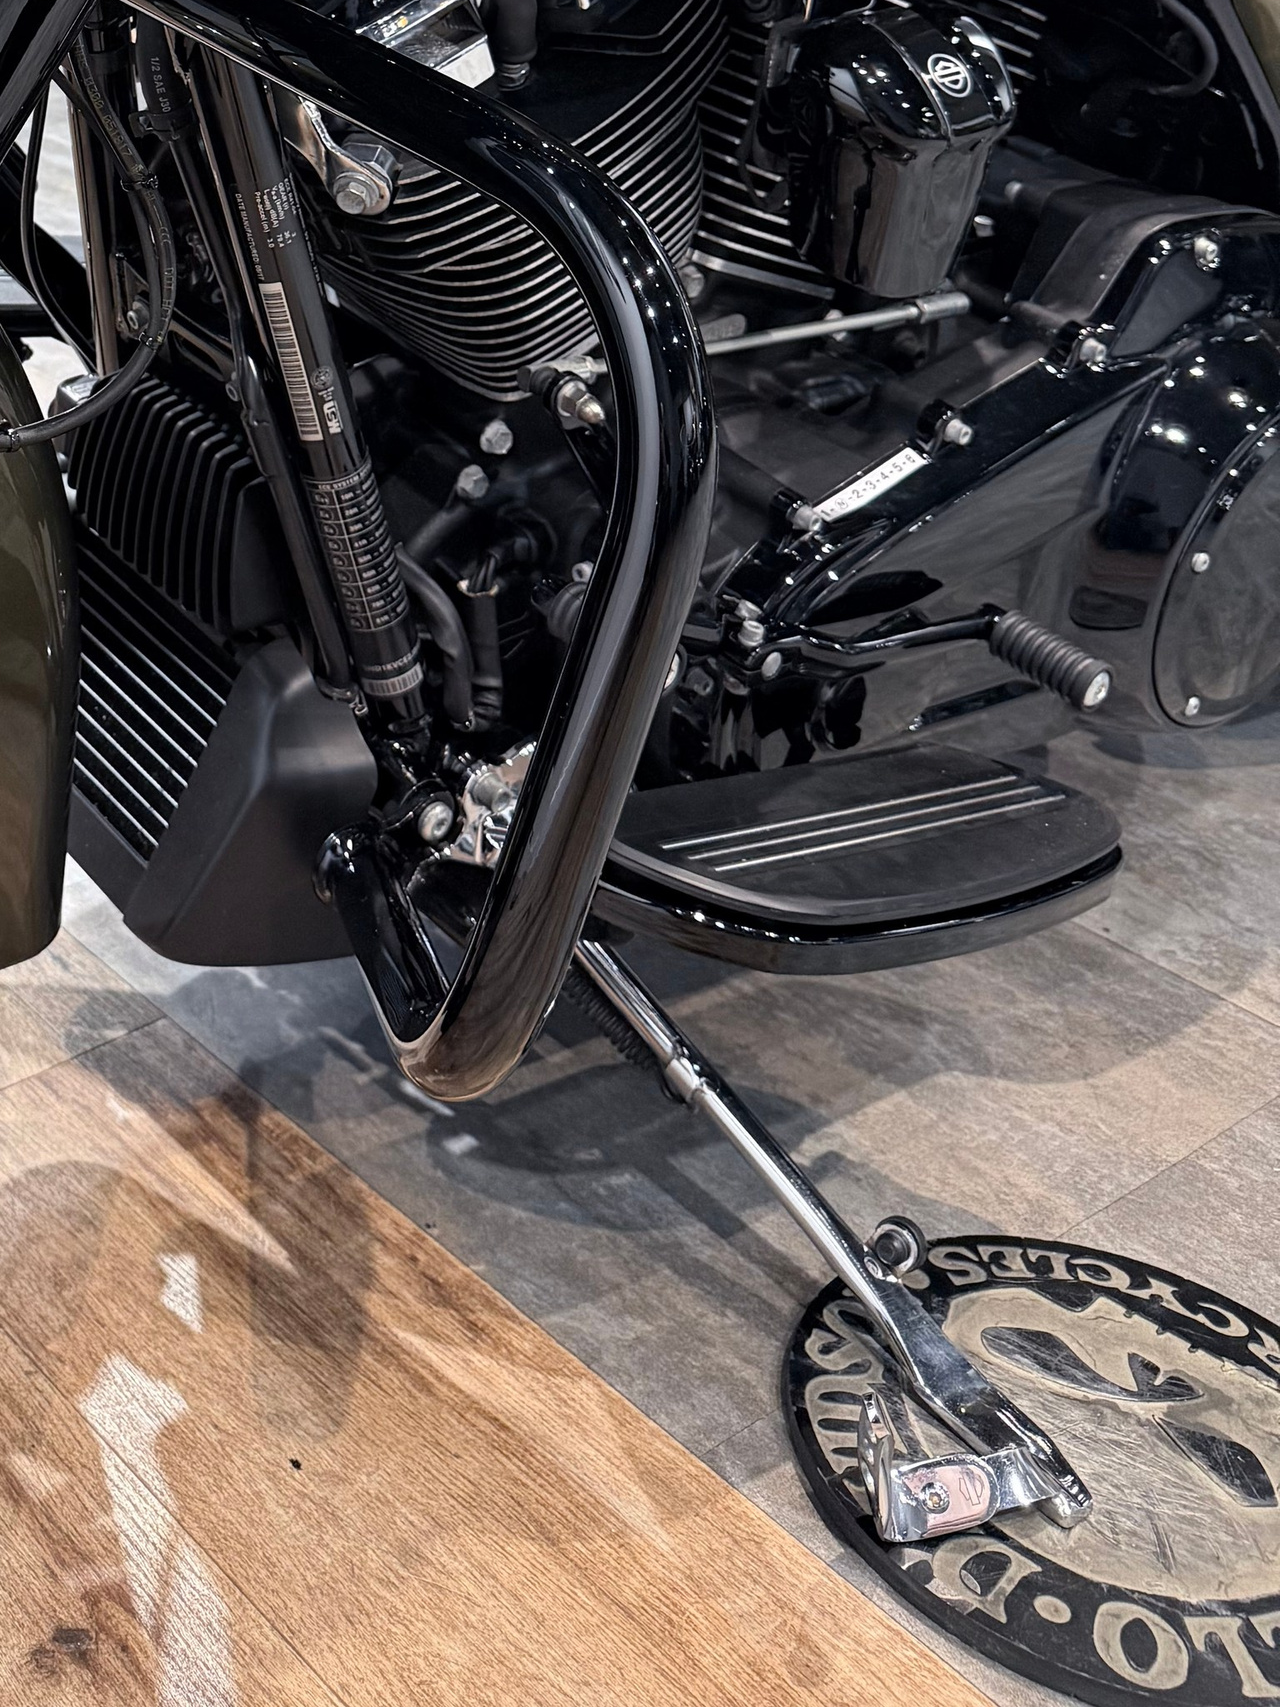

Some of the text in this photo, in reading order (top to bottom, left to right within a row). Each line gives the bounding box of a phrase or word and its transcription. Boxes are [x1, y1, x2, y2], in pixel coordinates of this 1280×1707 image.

[150, 56, 171, 113] 1/2 SAE J30
[235, 193, 246, 211] DATE
